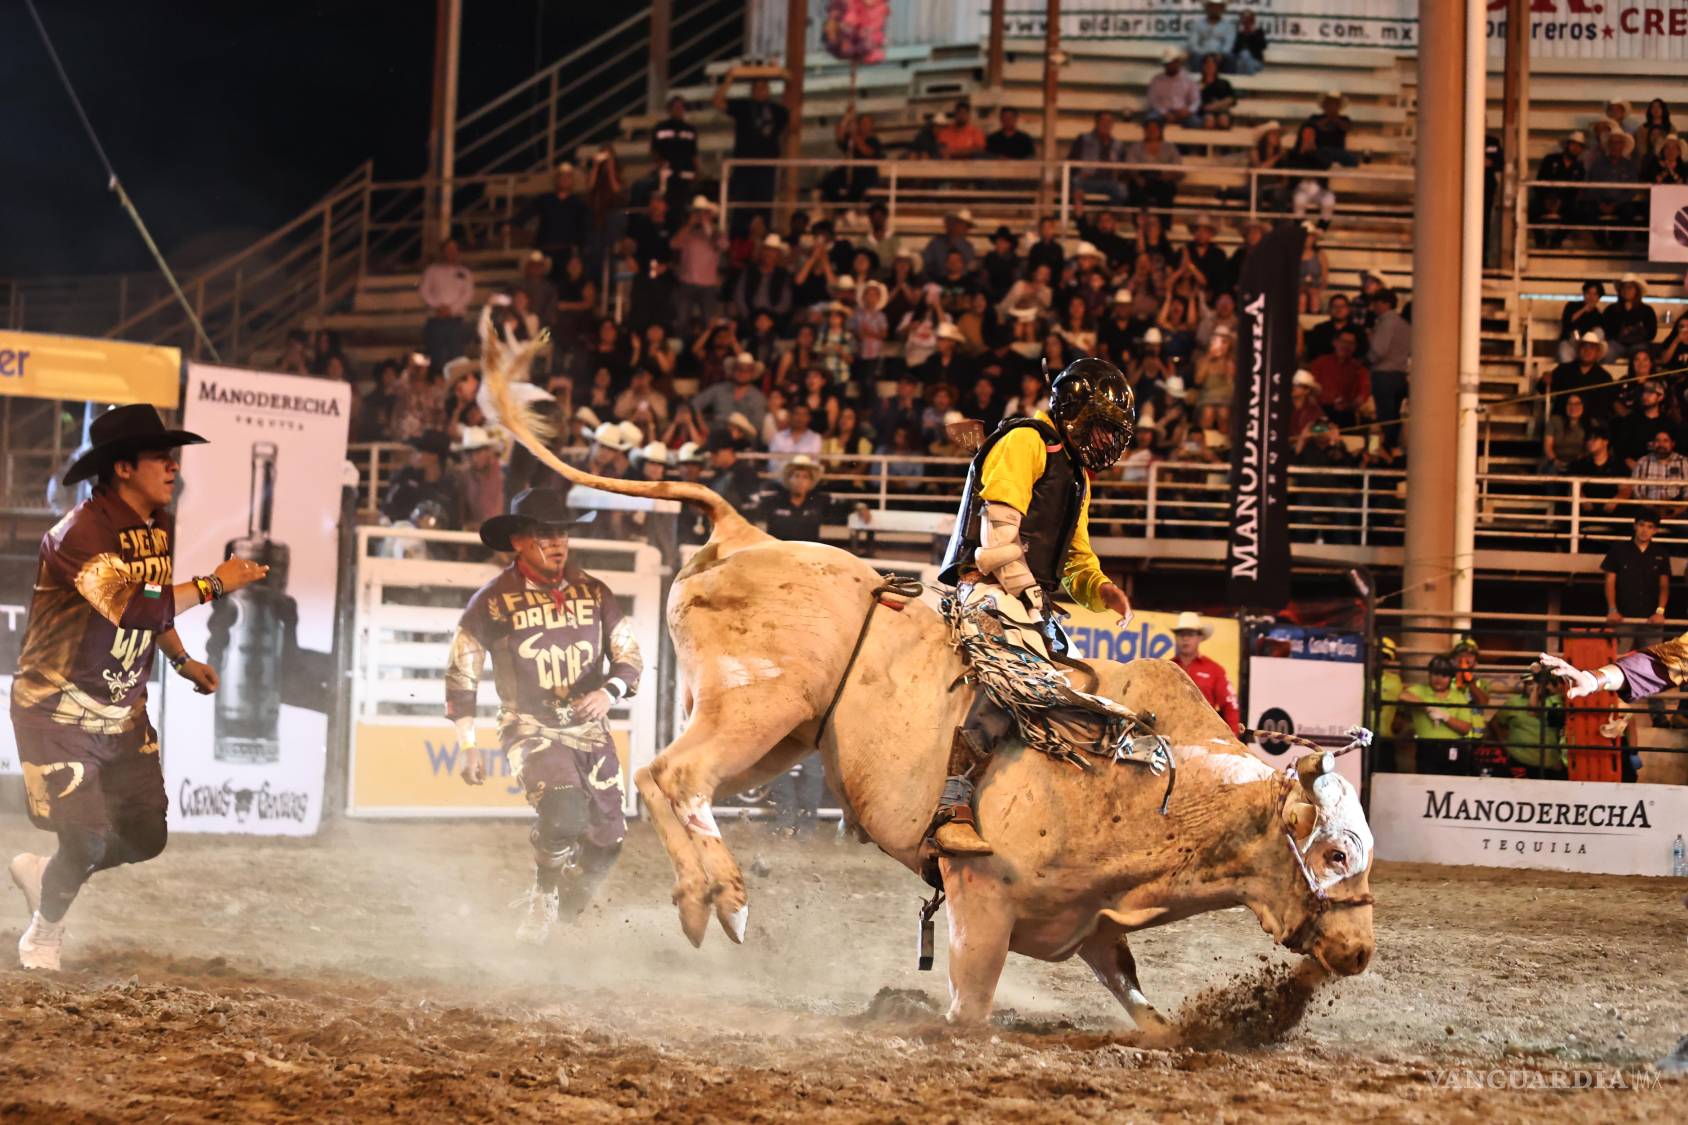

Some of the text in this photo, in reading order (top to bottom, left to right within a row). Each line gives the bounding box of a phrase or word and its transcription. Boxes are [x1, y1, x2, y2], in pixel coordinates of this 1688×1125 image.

[1381, 26, 1413, 40] mx
[198, 380, 340, 417] MANODERECHA
[1423, 790, 1652, 829] MANODERECHA
[1483, 838, 1587, 854] TEQUILA
